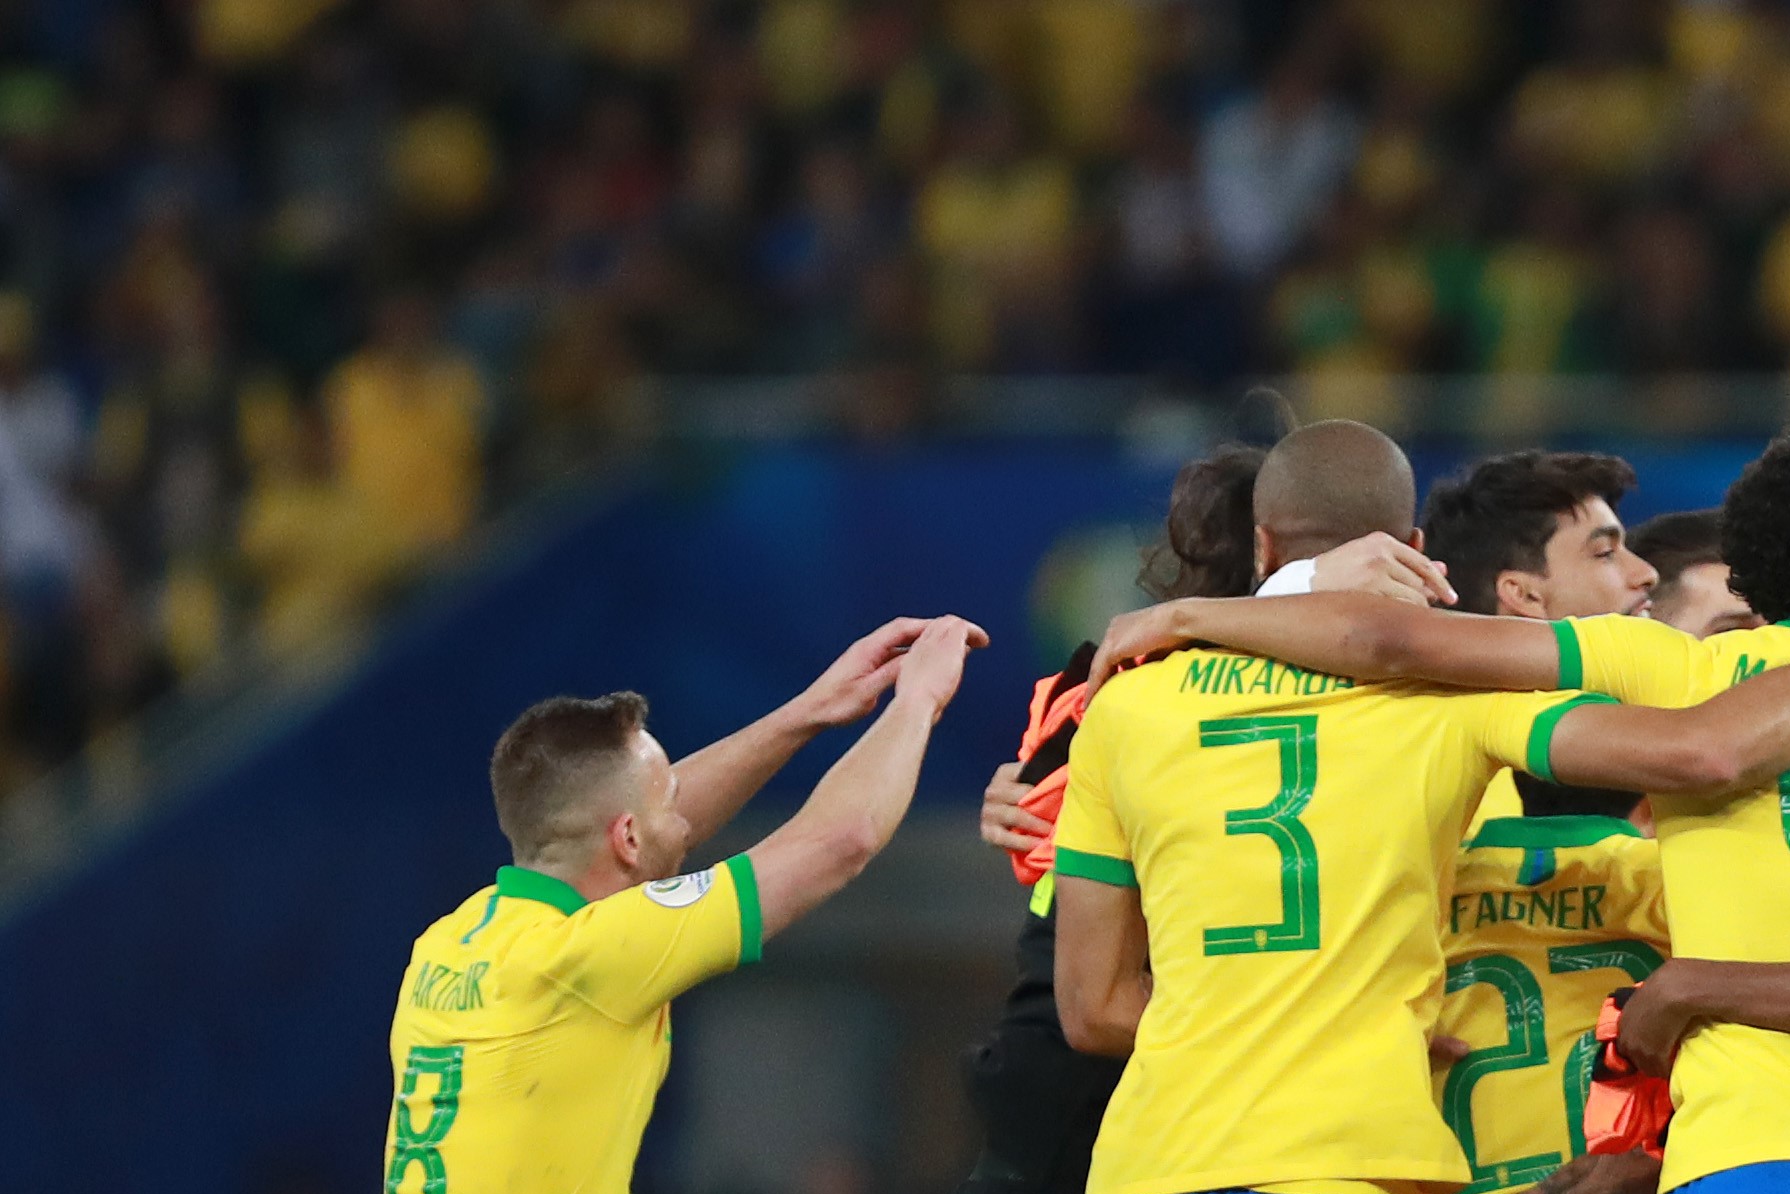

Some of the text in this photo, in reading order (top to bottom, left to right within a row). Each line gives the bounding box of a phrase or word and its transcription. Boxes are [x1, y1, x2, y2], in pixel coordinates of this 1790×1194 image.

[1198, 714, 1321, 956] 3
[1451, 884, 1607, 934] FAGNER
[408, 960, 490, 1012] ARTHUR
